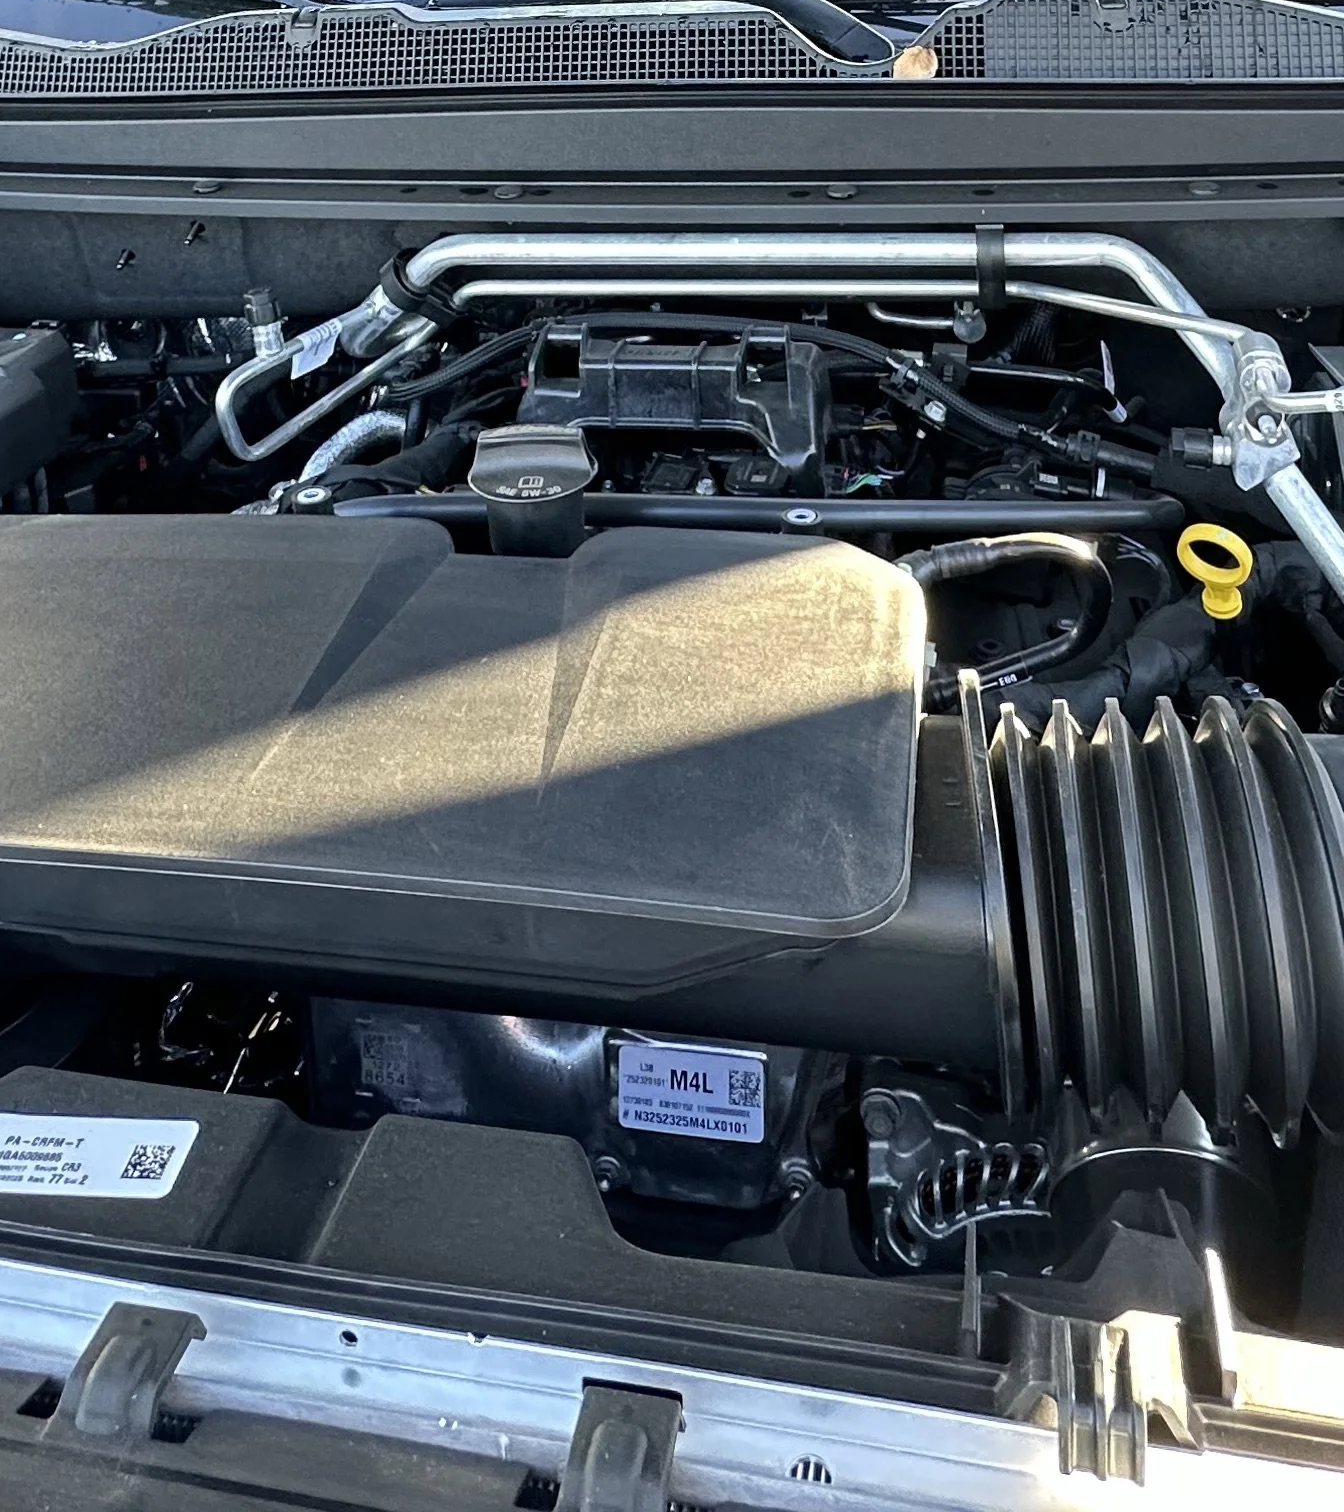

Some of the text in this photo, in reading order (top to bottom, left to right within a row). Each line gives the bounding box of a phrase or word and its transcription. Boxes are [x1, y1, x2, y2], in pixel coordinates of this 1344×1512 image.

[495, 485, 517, 497] SAE
[670, 1069, 714, 1094] M4L
[634, 1109, 748, 1135] N3252325M4LX0101
